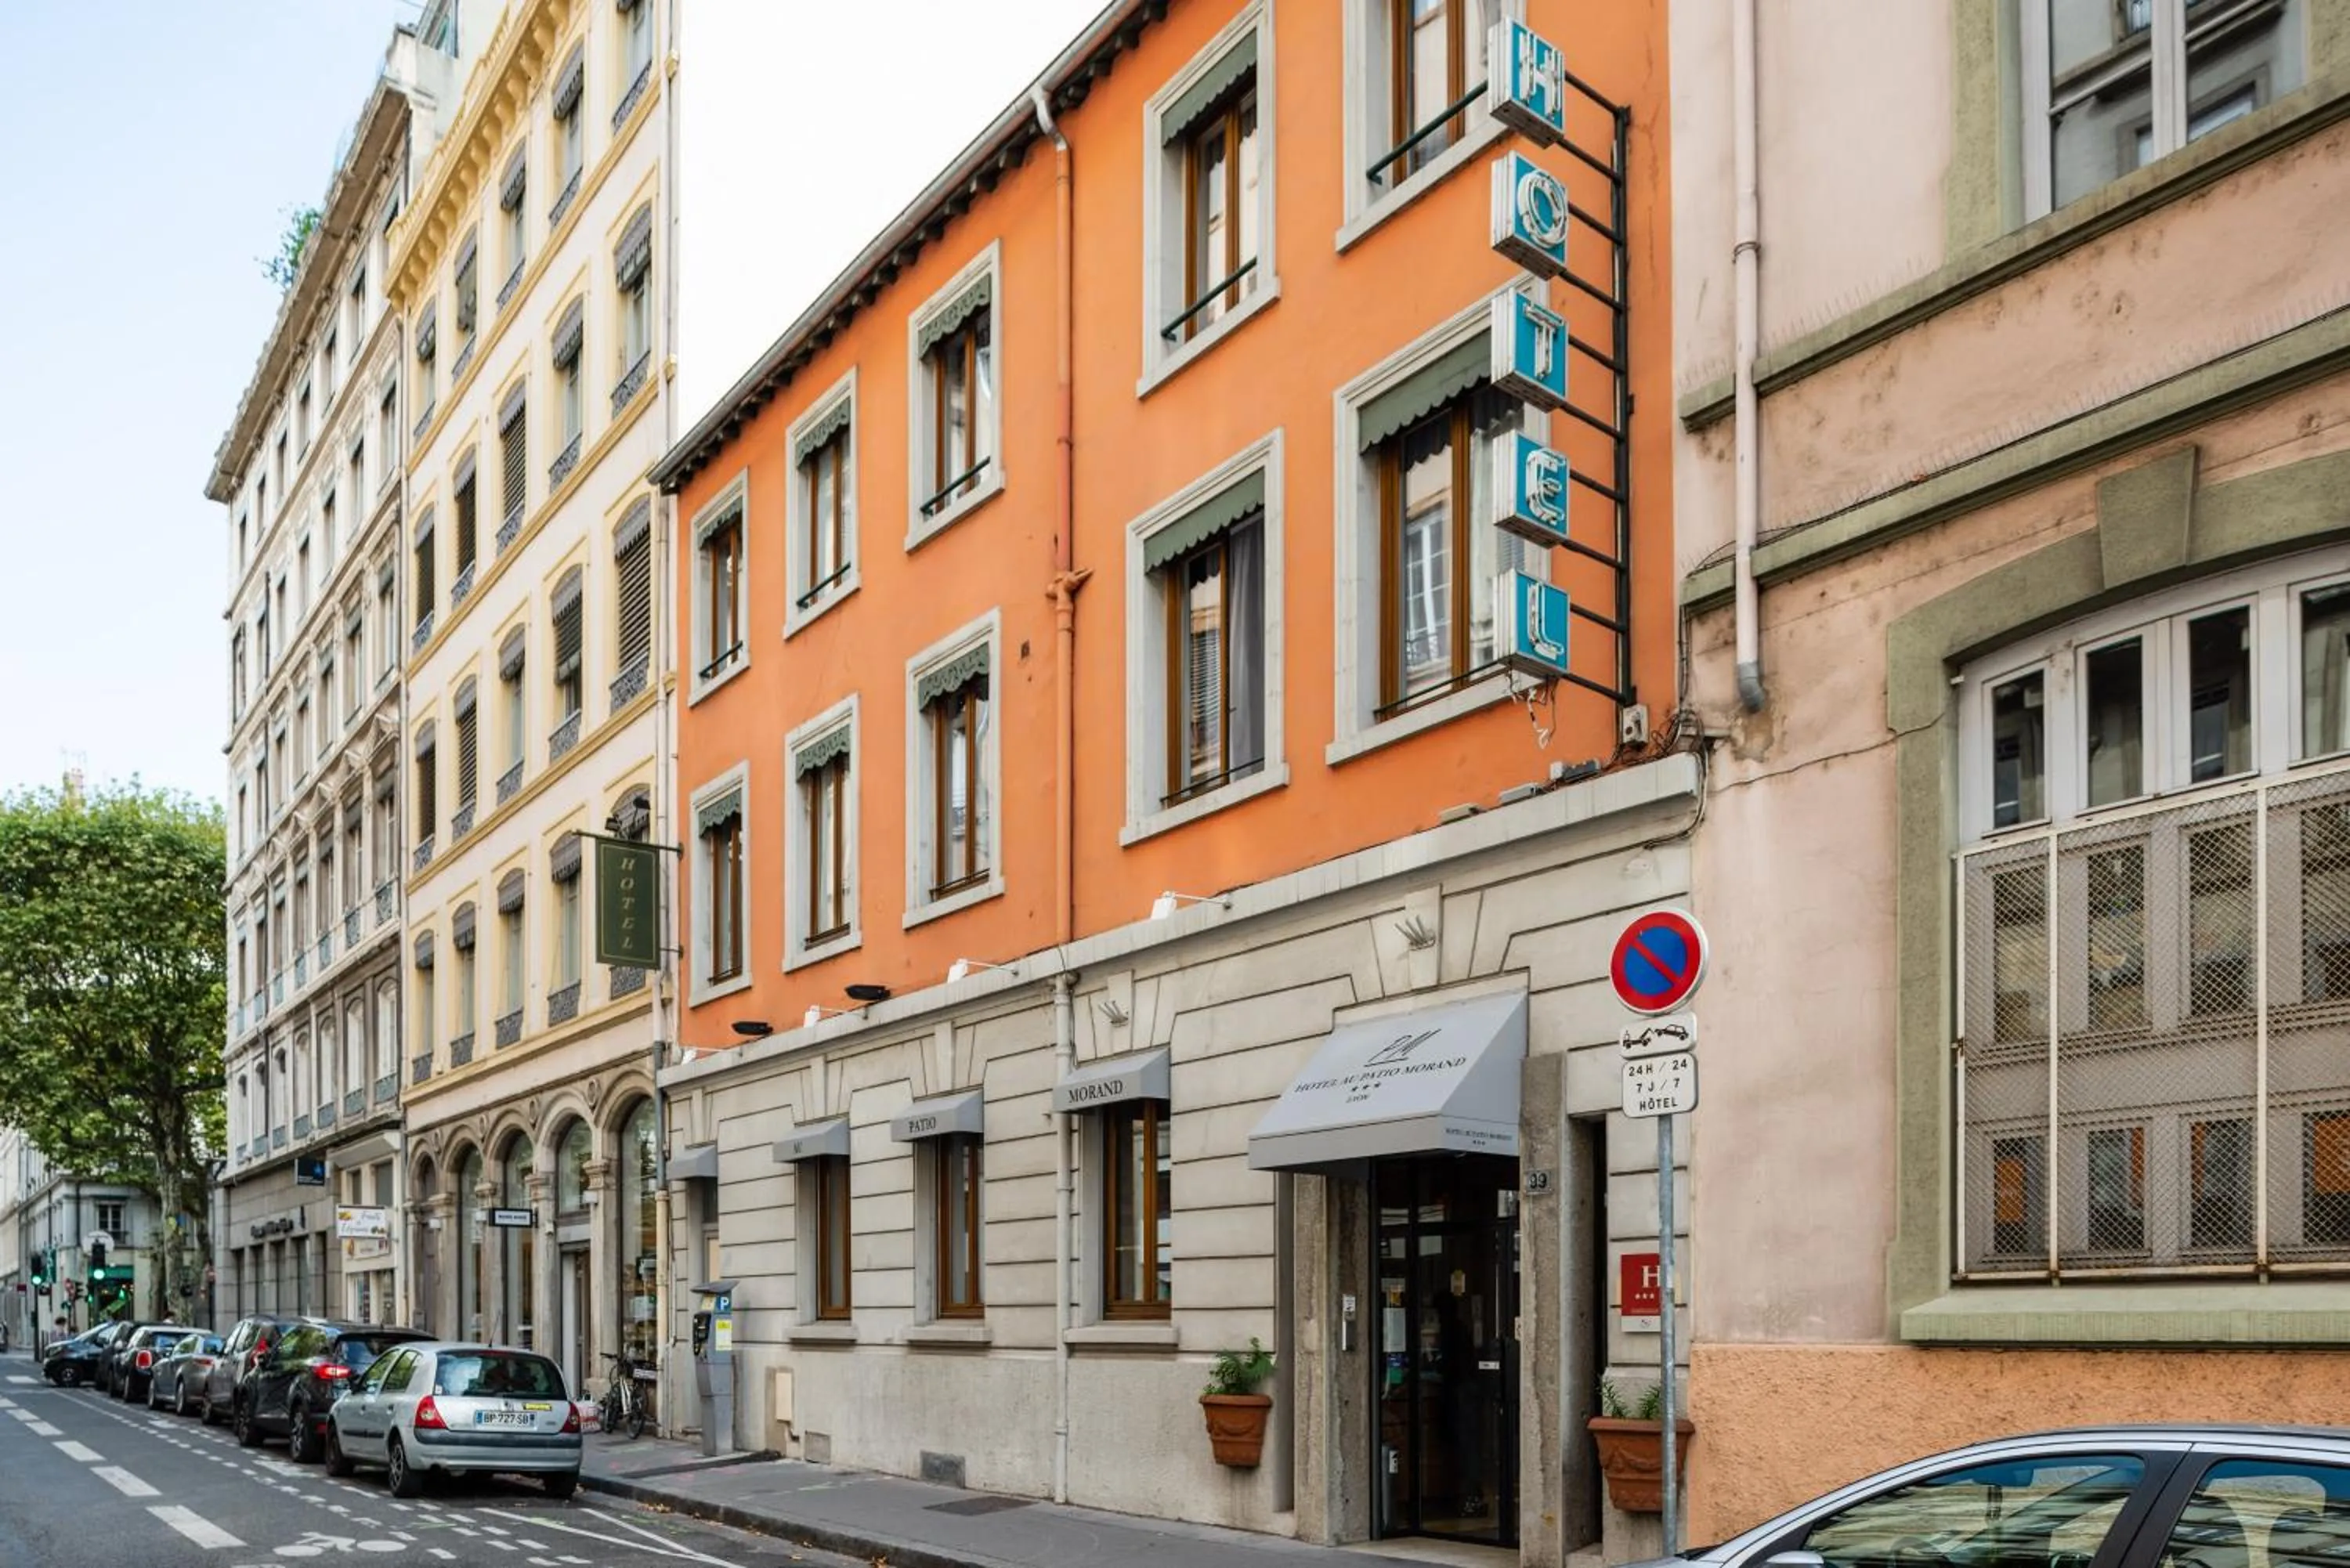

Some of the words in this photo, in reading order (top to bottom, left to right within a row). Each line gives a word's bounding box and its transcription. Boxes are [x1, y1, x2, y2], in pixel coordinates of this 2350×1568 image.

[1517, 31, 1567, 660] HOTEL
[620, 857, 637, 950] HOTEL
[1294, 1079, 1337, 1093] HOTEL
[1340, 1074, 1358, 1086] AU
[1358, 1067, 1401, 1082] PATIO
[1403, 1056, 1466, 1074] MORAND
[1672, 1059, 1687, 1071] 24
[1068, 1079, 1123, 1103] MORAND
[1673, 1078, 1680, 1088] 7
[1640, 1097, 1678, 1111] HÔTEL
[909, 1116, 936, 1133] PATIO
[1642, 1265, 1661, 1288] H
[720, 1296, 729, 1310] P
